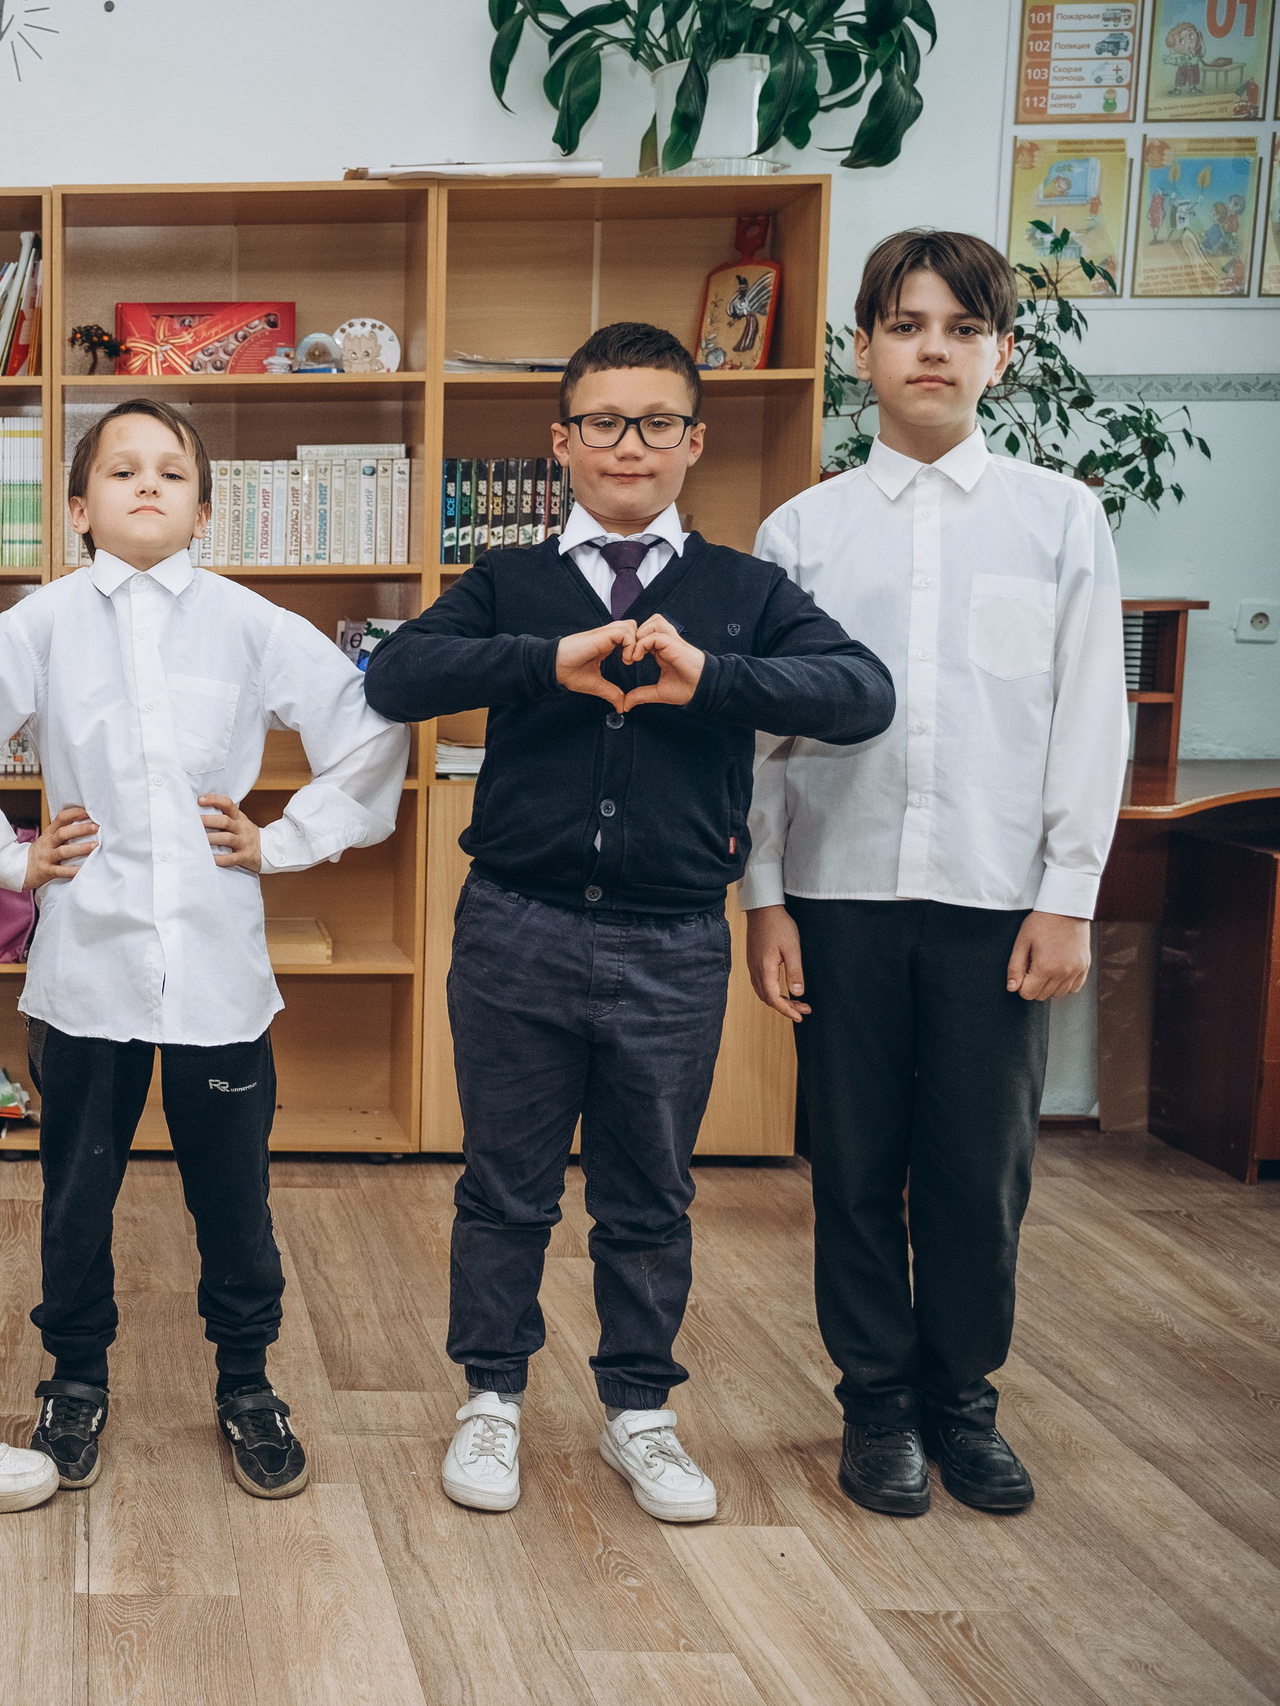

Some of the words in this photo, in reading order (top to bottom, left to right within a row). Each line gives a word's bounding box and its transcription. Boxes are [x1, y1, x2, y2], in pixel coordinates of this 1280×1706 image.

[1030, 12, 1052, 24] 101
[1056, 12, 1100, 21] Пожарные
[1028, 41, 1050, 52] 102
[1054, 42, 1091, 51] Полиция
[1026, 68, 1048, 80] 103
[1024, 96, 1046, 108] 112
[1050, 92, 1082, 100] Единый
[233, 484, 242, 506] МИР
[246, 482, 256, 505] МИР
[262, 488, 270, 508] МИР
[260, 511, 270, 550] ПОЗНАЮ
